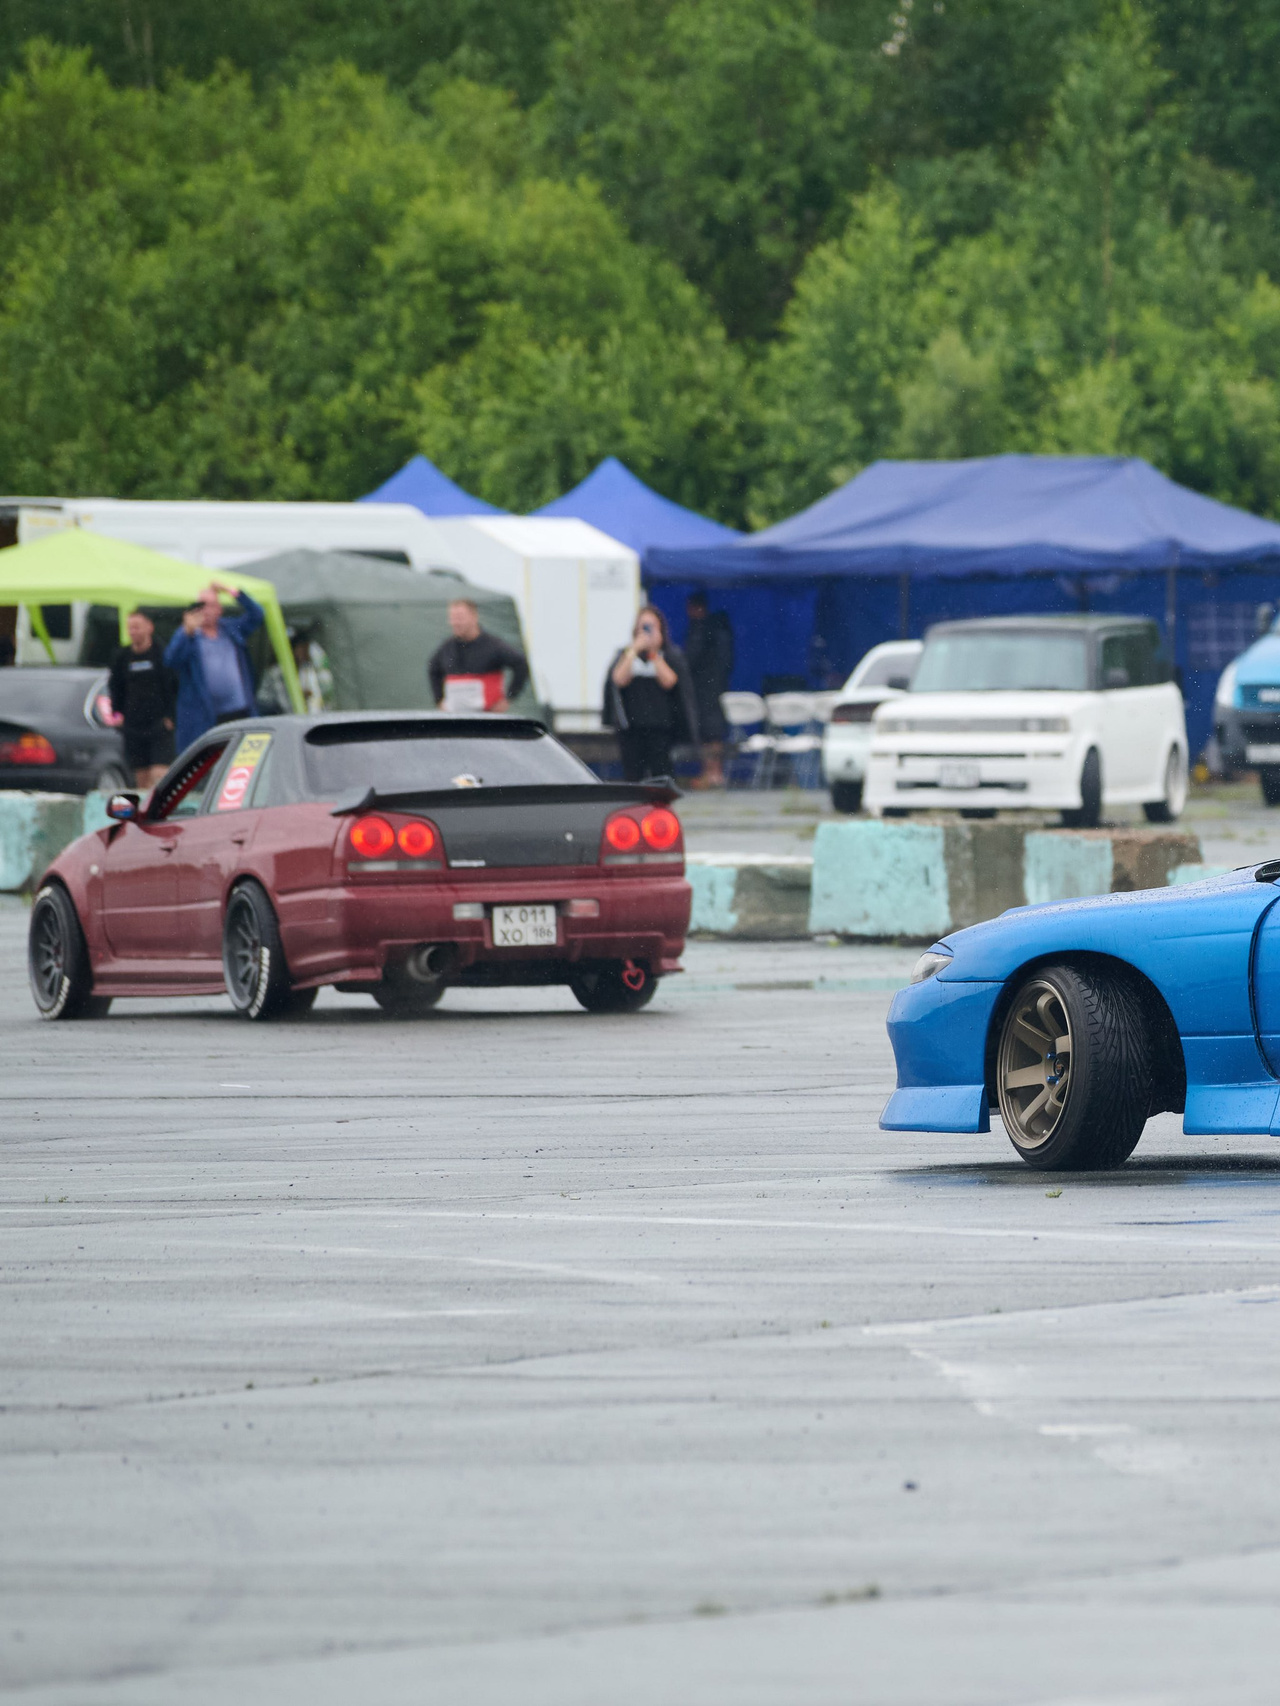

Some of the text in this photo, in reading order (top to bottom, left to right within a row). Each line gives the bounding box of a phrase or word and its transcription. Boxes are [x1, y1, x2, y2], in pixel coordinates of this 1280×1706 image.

[519, 908, 547, 923] 011
[500, 926, 553, 944] ХО 186
